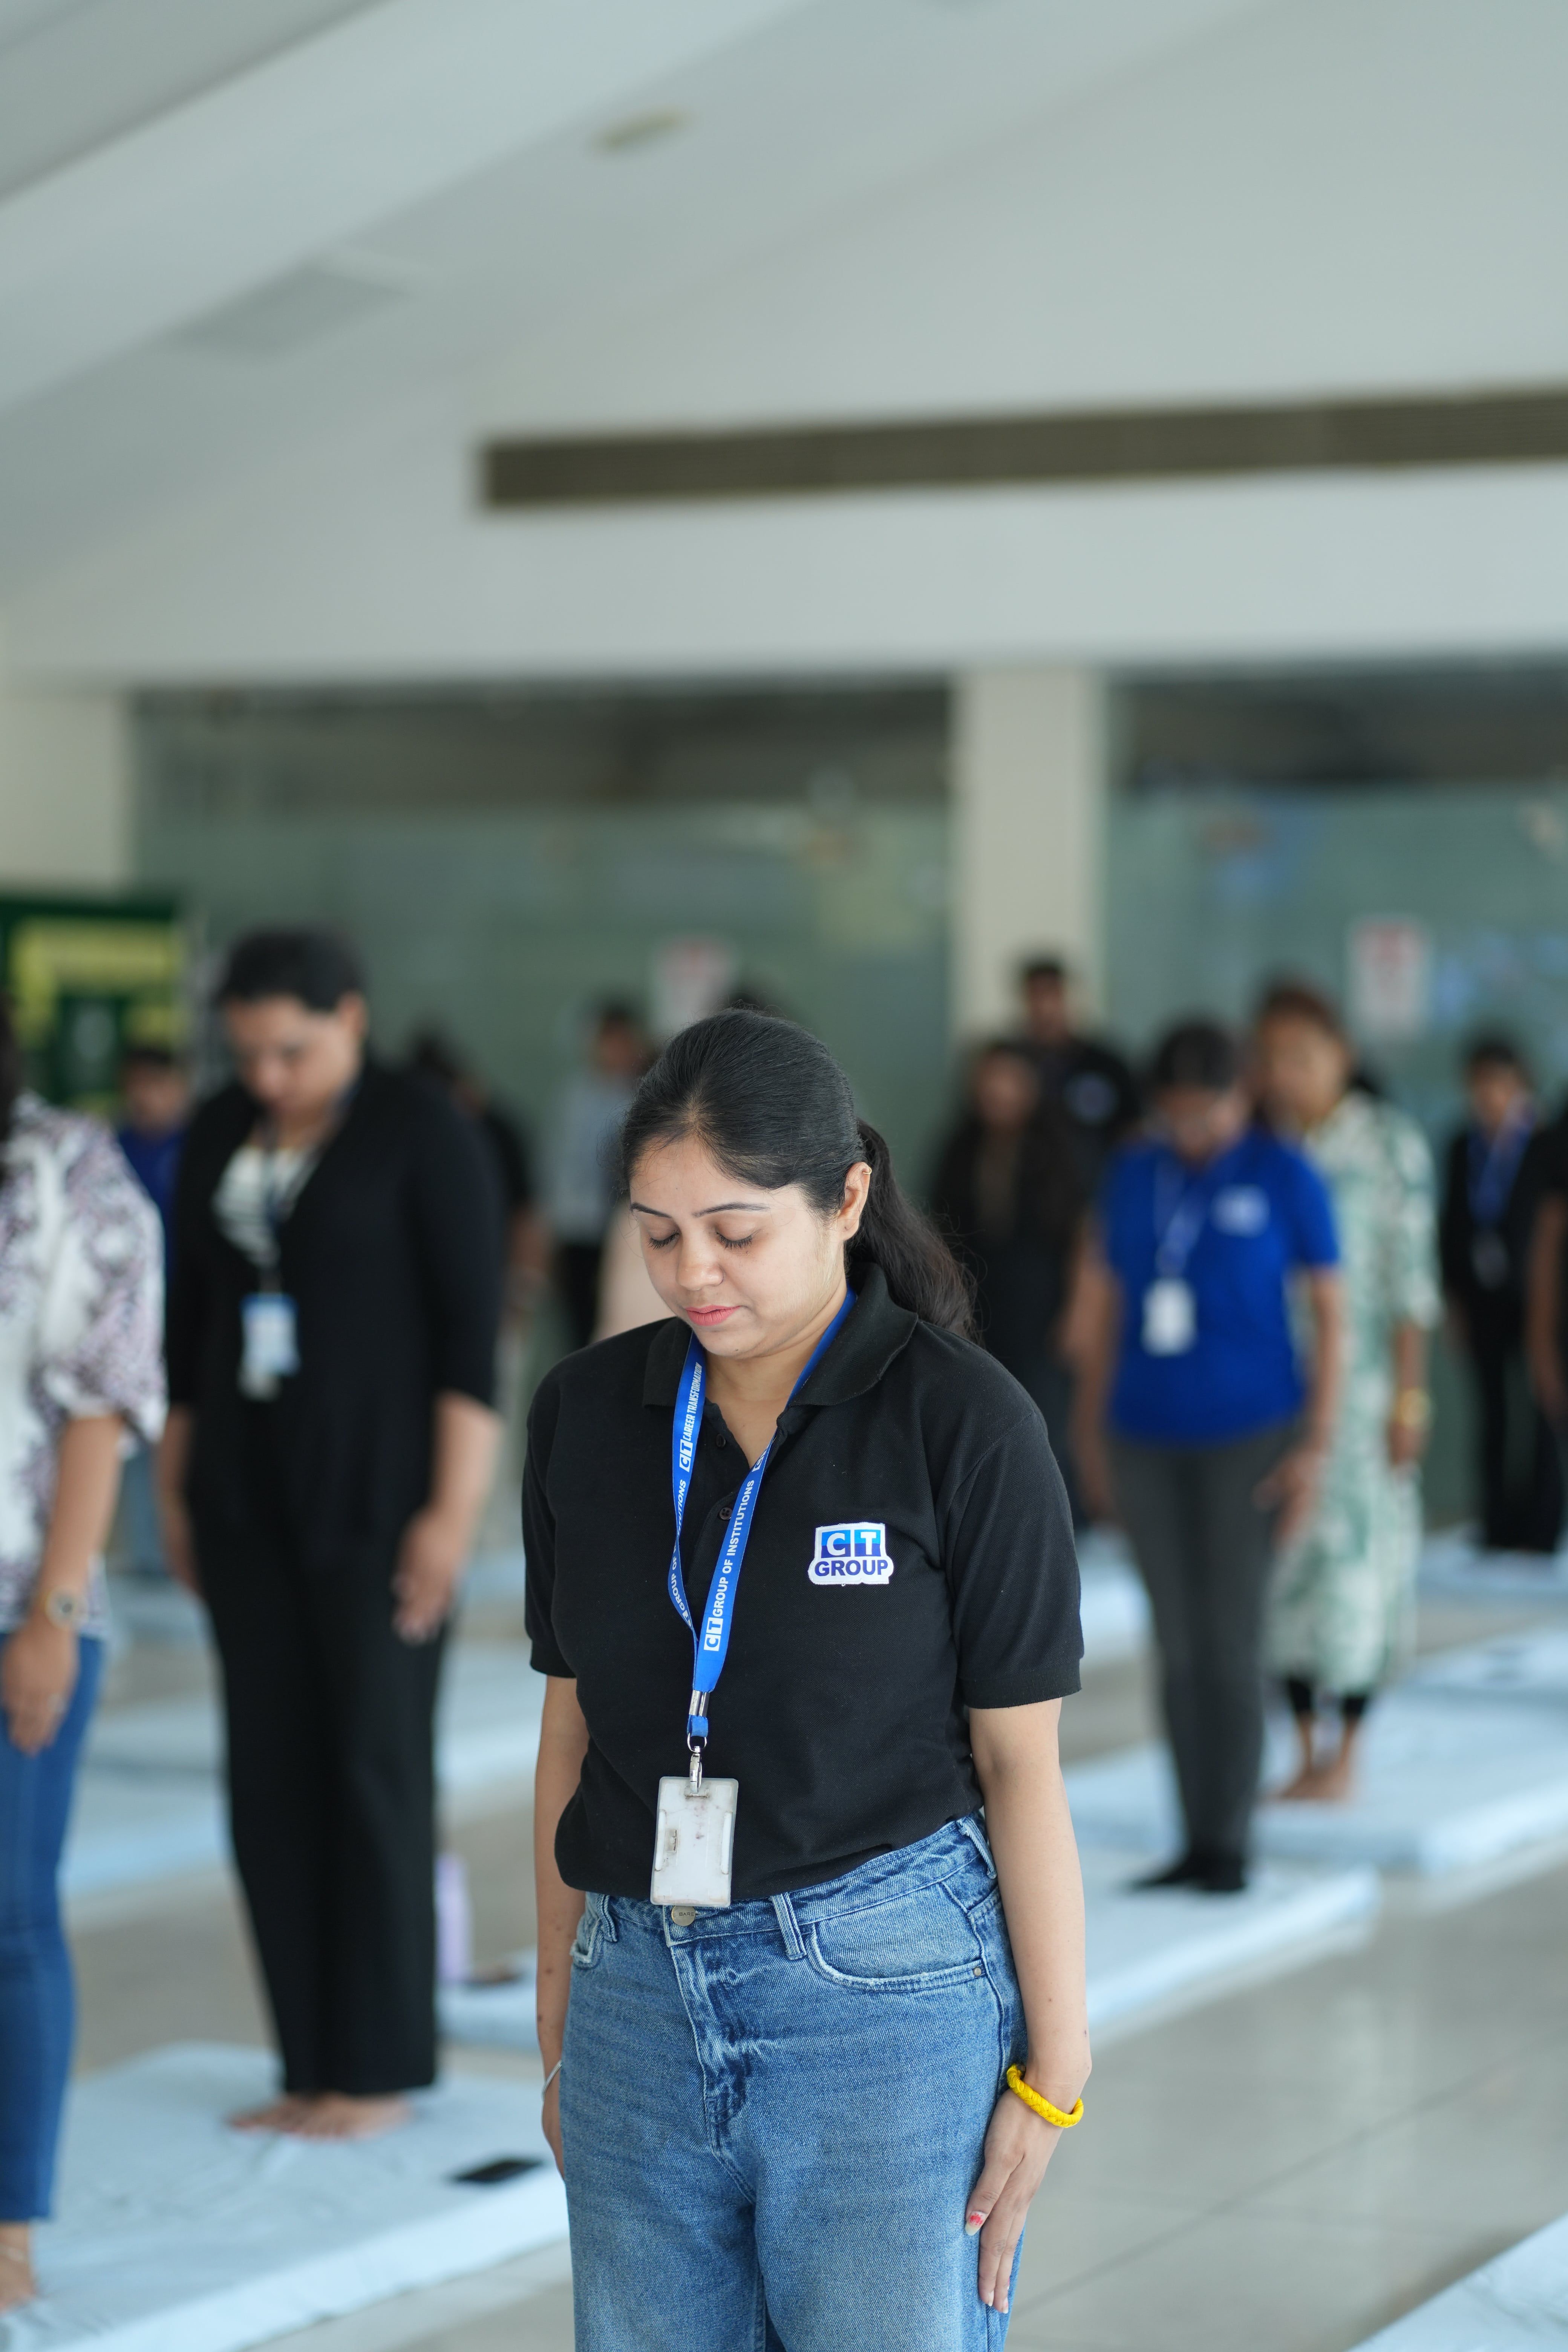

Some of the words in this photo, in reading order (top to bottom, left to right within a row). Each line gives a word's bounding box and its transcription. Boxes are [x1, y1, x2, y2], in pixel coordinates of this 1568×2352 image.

[687, 1362, 702, 1414] TRANSFORMATION
[683, 1414, 695, 1441] CAREER
[680, 1441, 692, 1470] CT
[727, 1480, 754, 1556] INSTITUTIONS
[824, 1531, 878, 1557] CT
[672, 1556, 677, 1570] OF
[722, 1559, 733, 1574] OF
[815, 1560, 888, 1576] GROUP
[671, 1573, 685, 1611] GROUP
[712, 1577, 729, 1617] GROUP
[705, 1619, 722, 1650] CT
